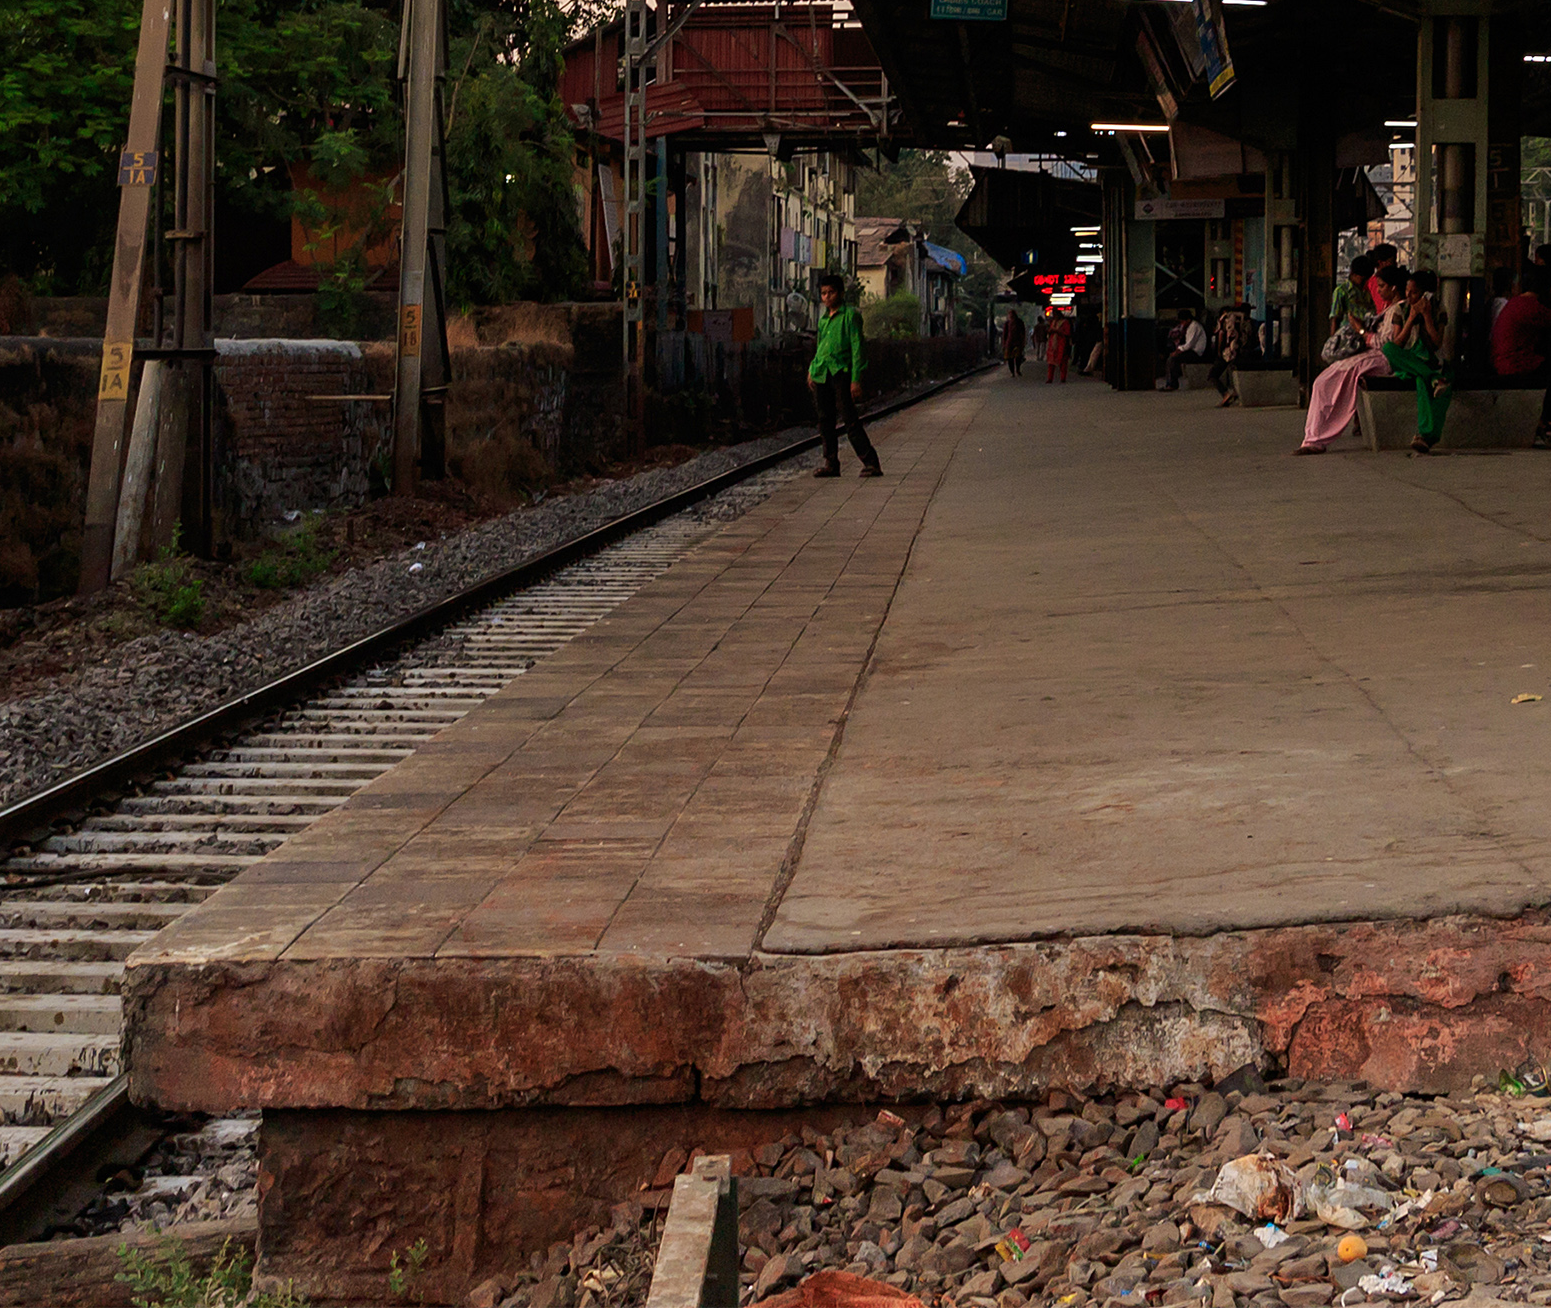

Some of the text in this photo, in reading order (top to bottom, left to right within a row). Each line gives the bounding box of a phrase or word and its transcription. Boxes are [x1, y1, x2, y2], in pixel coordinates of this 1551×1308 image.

[134, 152, 145, 167] 5
[406, 310, 416, 324] 5
[110, 347, 123, 365] 5
